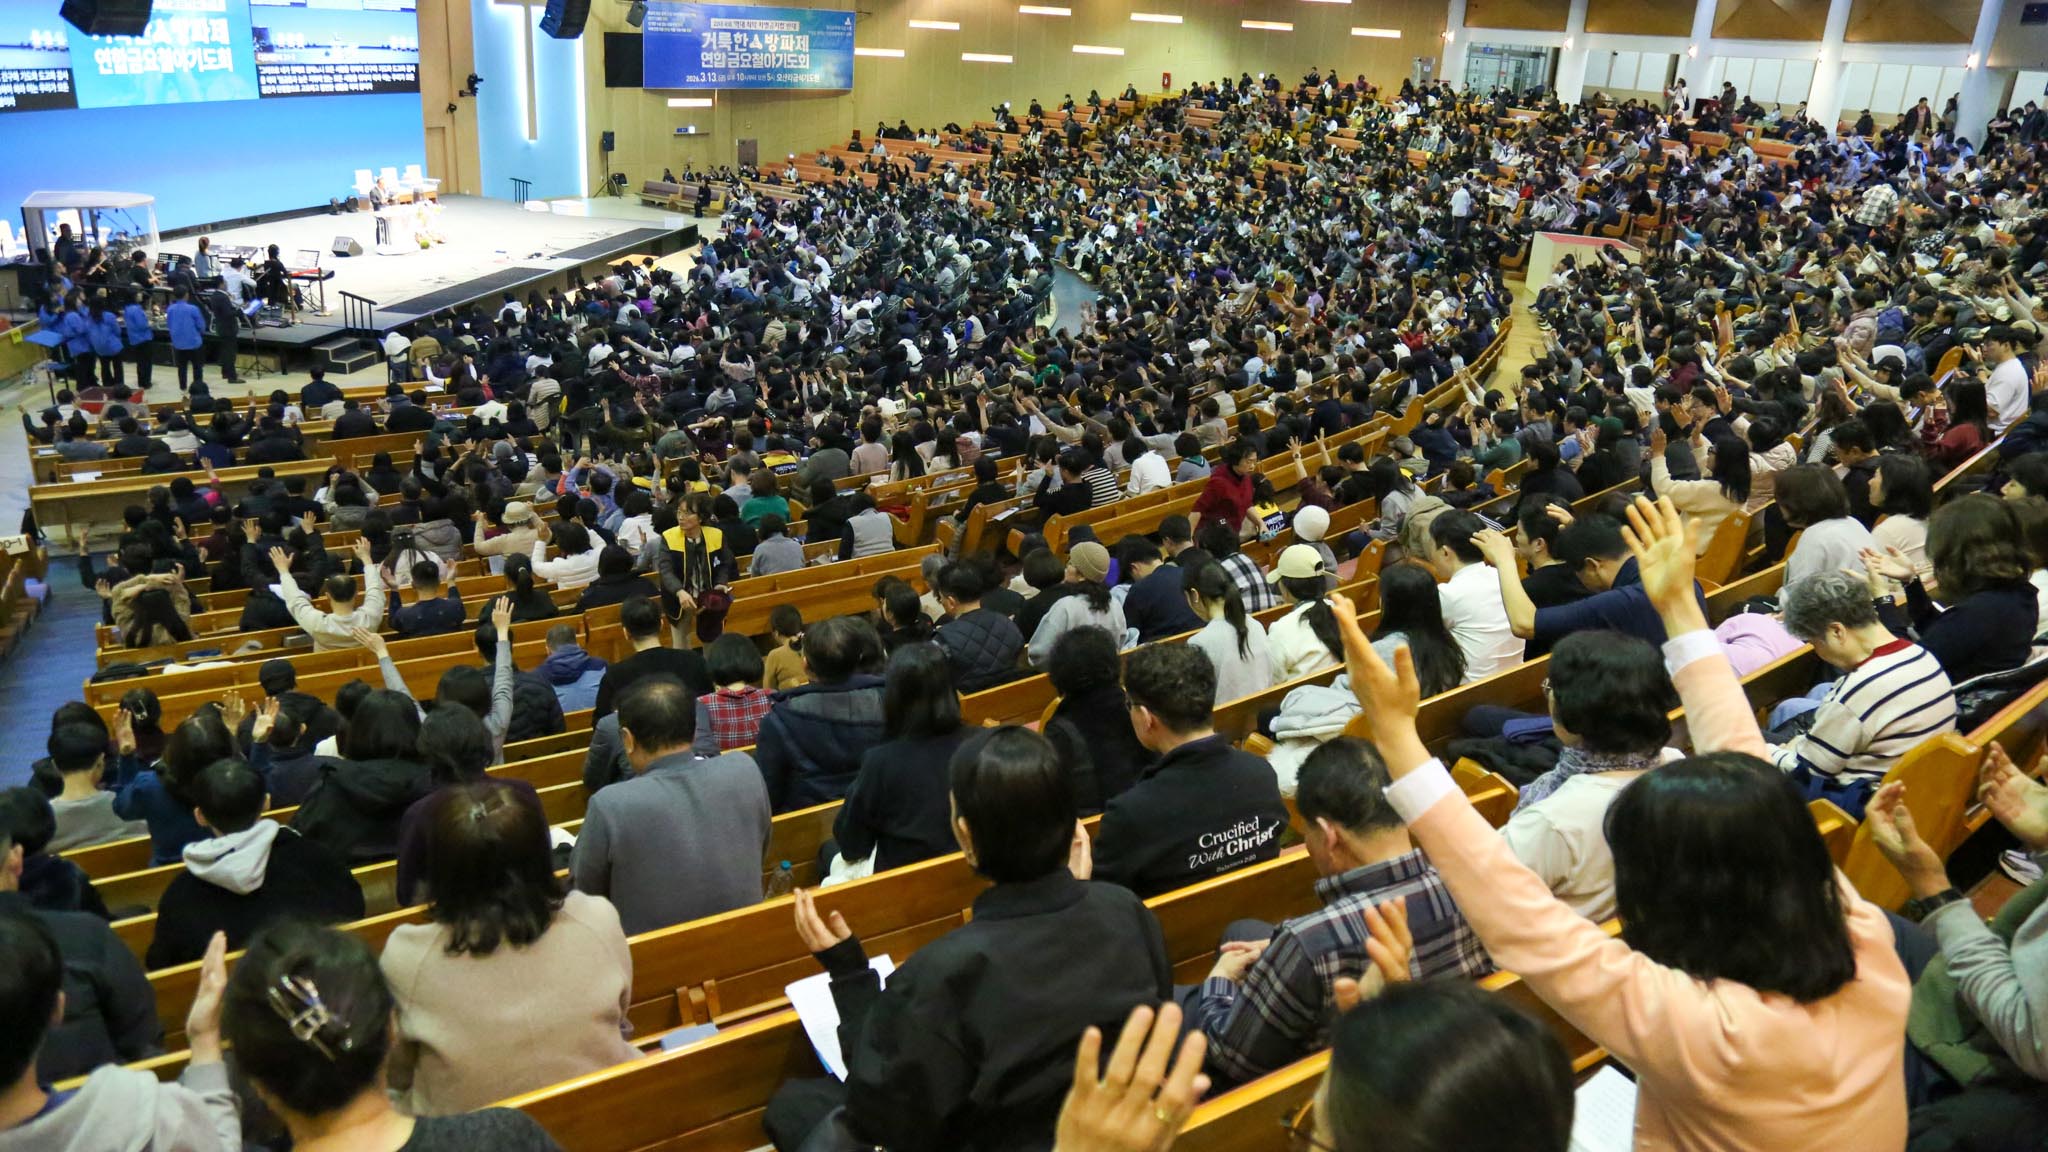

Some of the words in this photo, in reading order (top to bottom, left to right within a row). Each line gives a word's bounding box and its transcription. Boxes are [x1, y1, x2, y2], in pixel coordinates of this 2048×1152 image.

[701, 32, 748, 52] 거룩한
[764, 33, 809, 53] 방파제
[1188, 845, 1226, 869] With
[1226, 820, 1280, 856] Christ
[1198, 815, 1260, 849] Crucified
